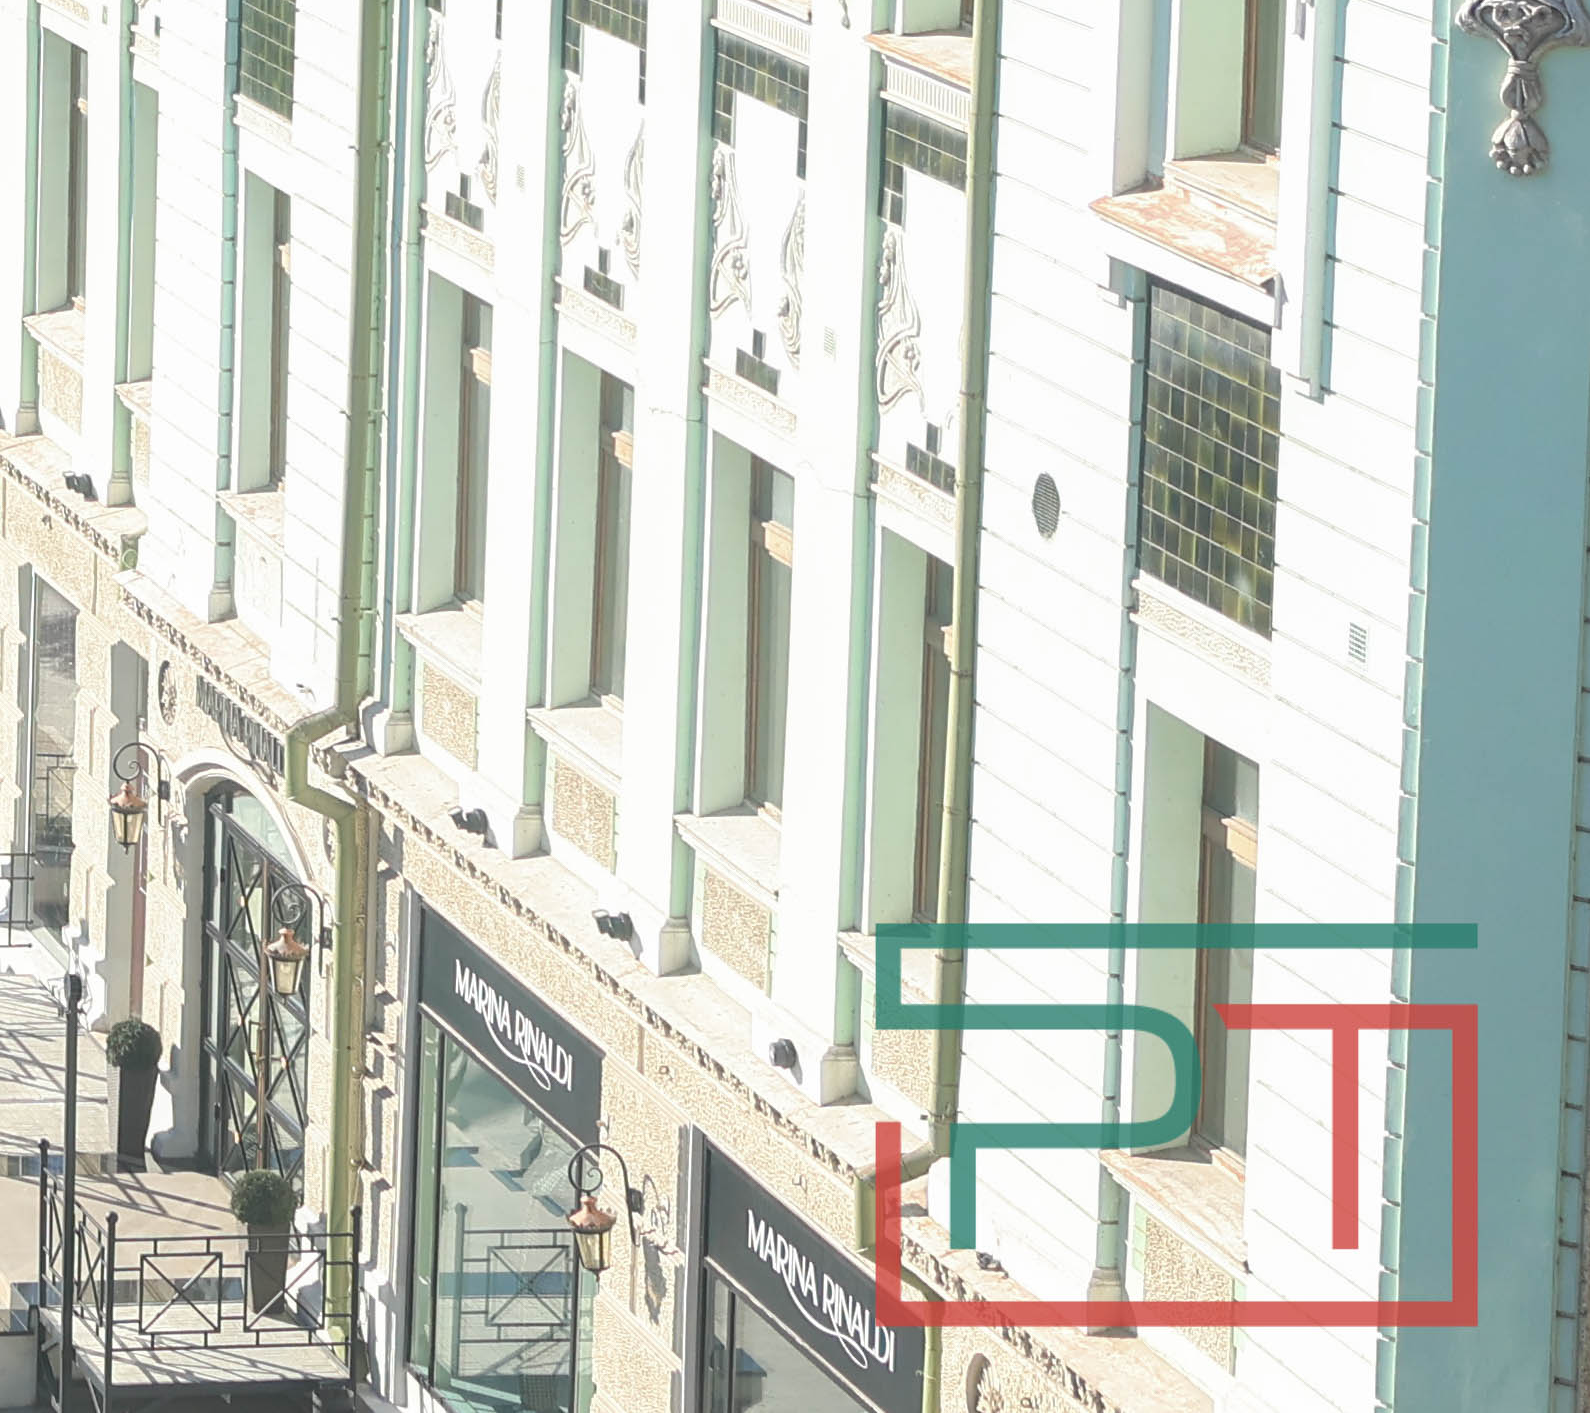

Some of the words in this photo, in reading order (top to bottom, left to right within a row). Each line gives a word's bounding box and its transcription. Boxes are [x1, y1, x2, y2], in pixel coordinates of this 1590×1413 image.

[455, 959, 512, 1040] MARINA
[515, 1010, 573, 1091] RINALDI
[748, 1209, 818, 1306] MARINA
[823, 1273, 895, 1372] RINALDI
